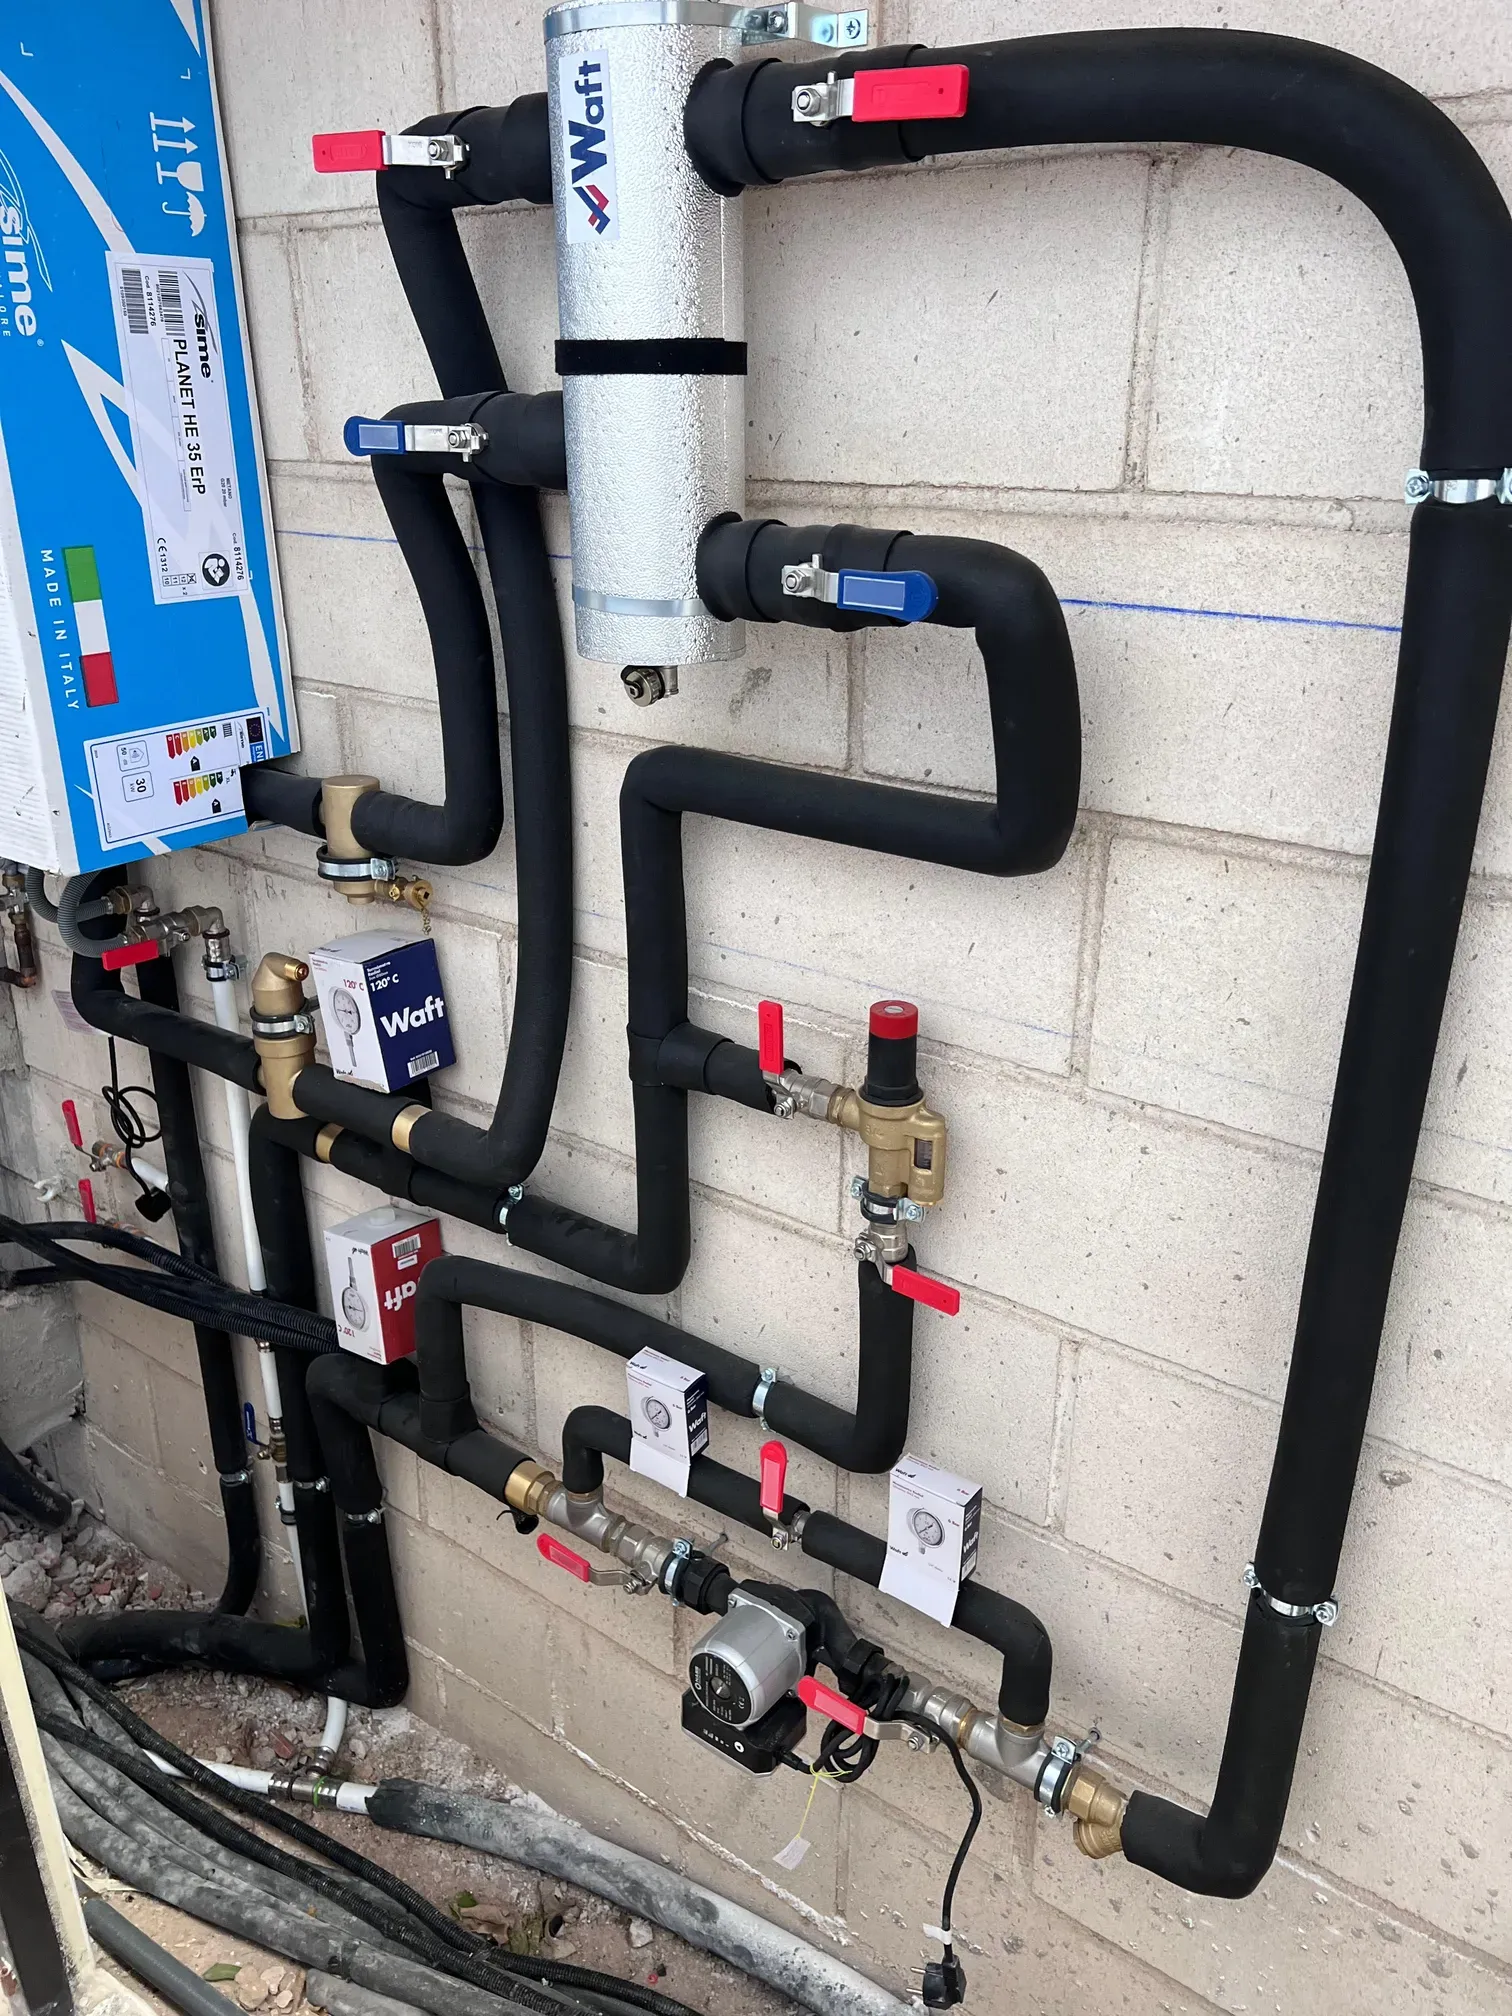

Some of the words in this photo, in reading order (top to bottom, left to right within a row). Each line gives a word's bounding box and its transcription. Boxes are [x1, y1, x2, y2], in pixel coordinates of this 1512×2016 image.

[568, 60, 608, 184] Waft
[0, 206, 37, 336] sime
[146, 292, 156, 326] 8114276
[194, 314, 212, 378] sime
[173, 339, 196, 409] PLANET
[183, 414, 199, 438] HE
[187, 443, 202, 461] 35
[190, 466, 205, 494] ErP
[41, 549, 62, 607] MADE
[234, 547, 244, 580] 8114276
[53, 620, 67, 640] IN
[59, 653, 80, 709] ITALY
[130, 783, 136, 792] kW
[136, 778, 146, 792] 30
[343, 979, 357, 989] 120°
[358, 982, 364, 991] C
[370, 977, 390, 992] 120°
[393, 974, 400, 983] C
[380, 995, 445, 1038] Waft
[384, 1278, 420, 1312] aft
